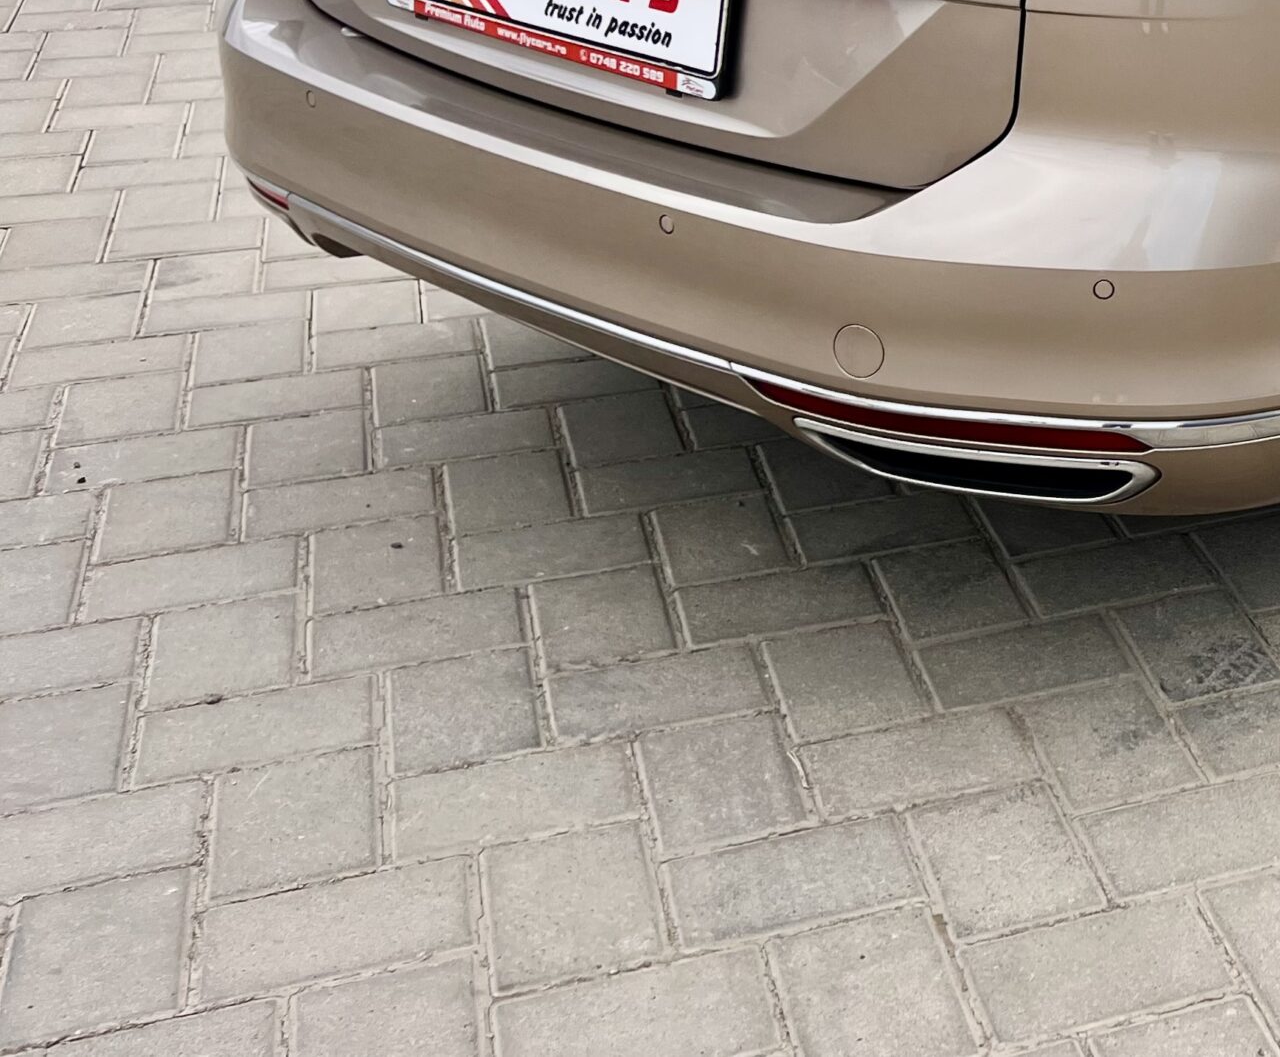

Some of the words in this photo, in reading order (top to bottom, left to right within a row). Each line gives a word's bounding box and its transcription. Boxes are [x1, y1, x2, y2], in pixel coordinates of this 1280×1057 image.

[424, 1, 463, 25] Premium
[463, 13, 486, 32] Auto
[497, 26, 568, 56] www.flycars.ro
[589, 52, 617, 70] 0748
[619, 60, 641, 76] 220
[585, 8, 602, 30] in
[605, 17, 673, 48] passion
